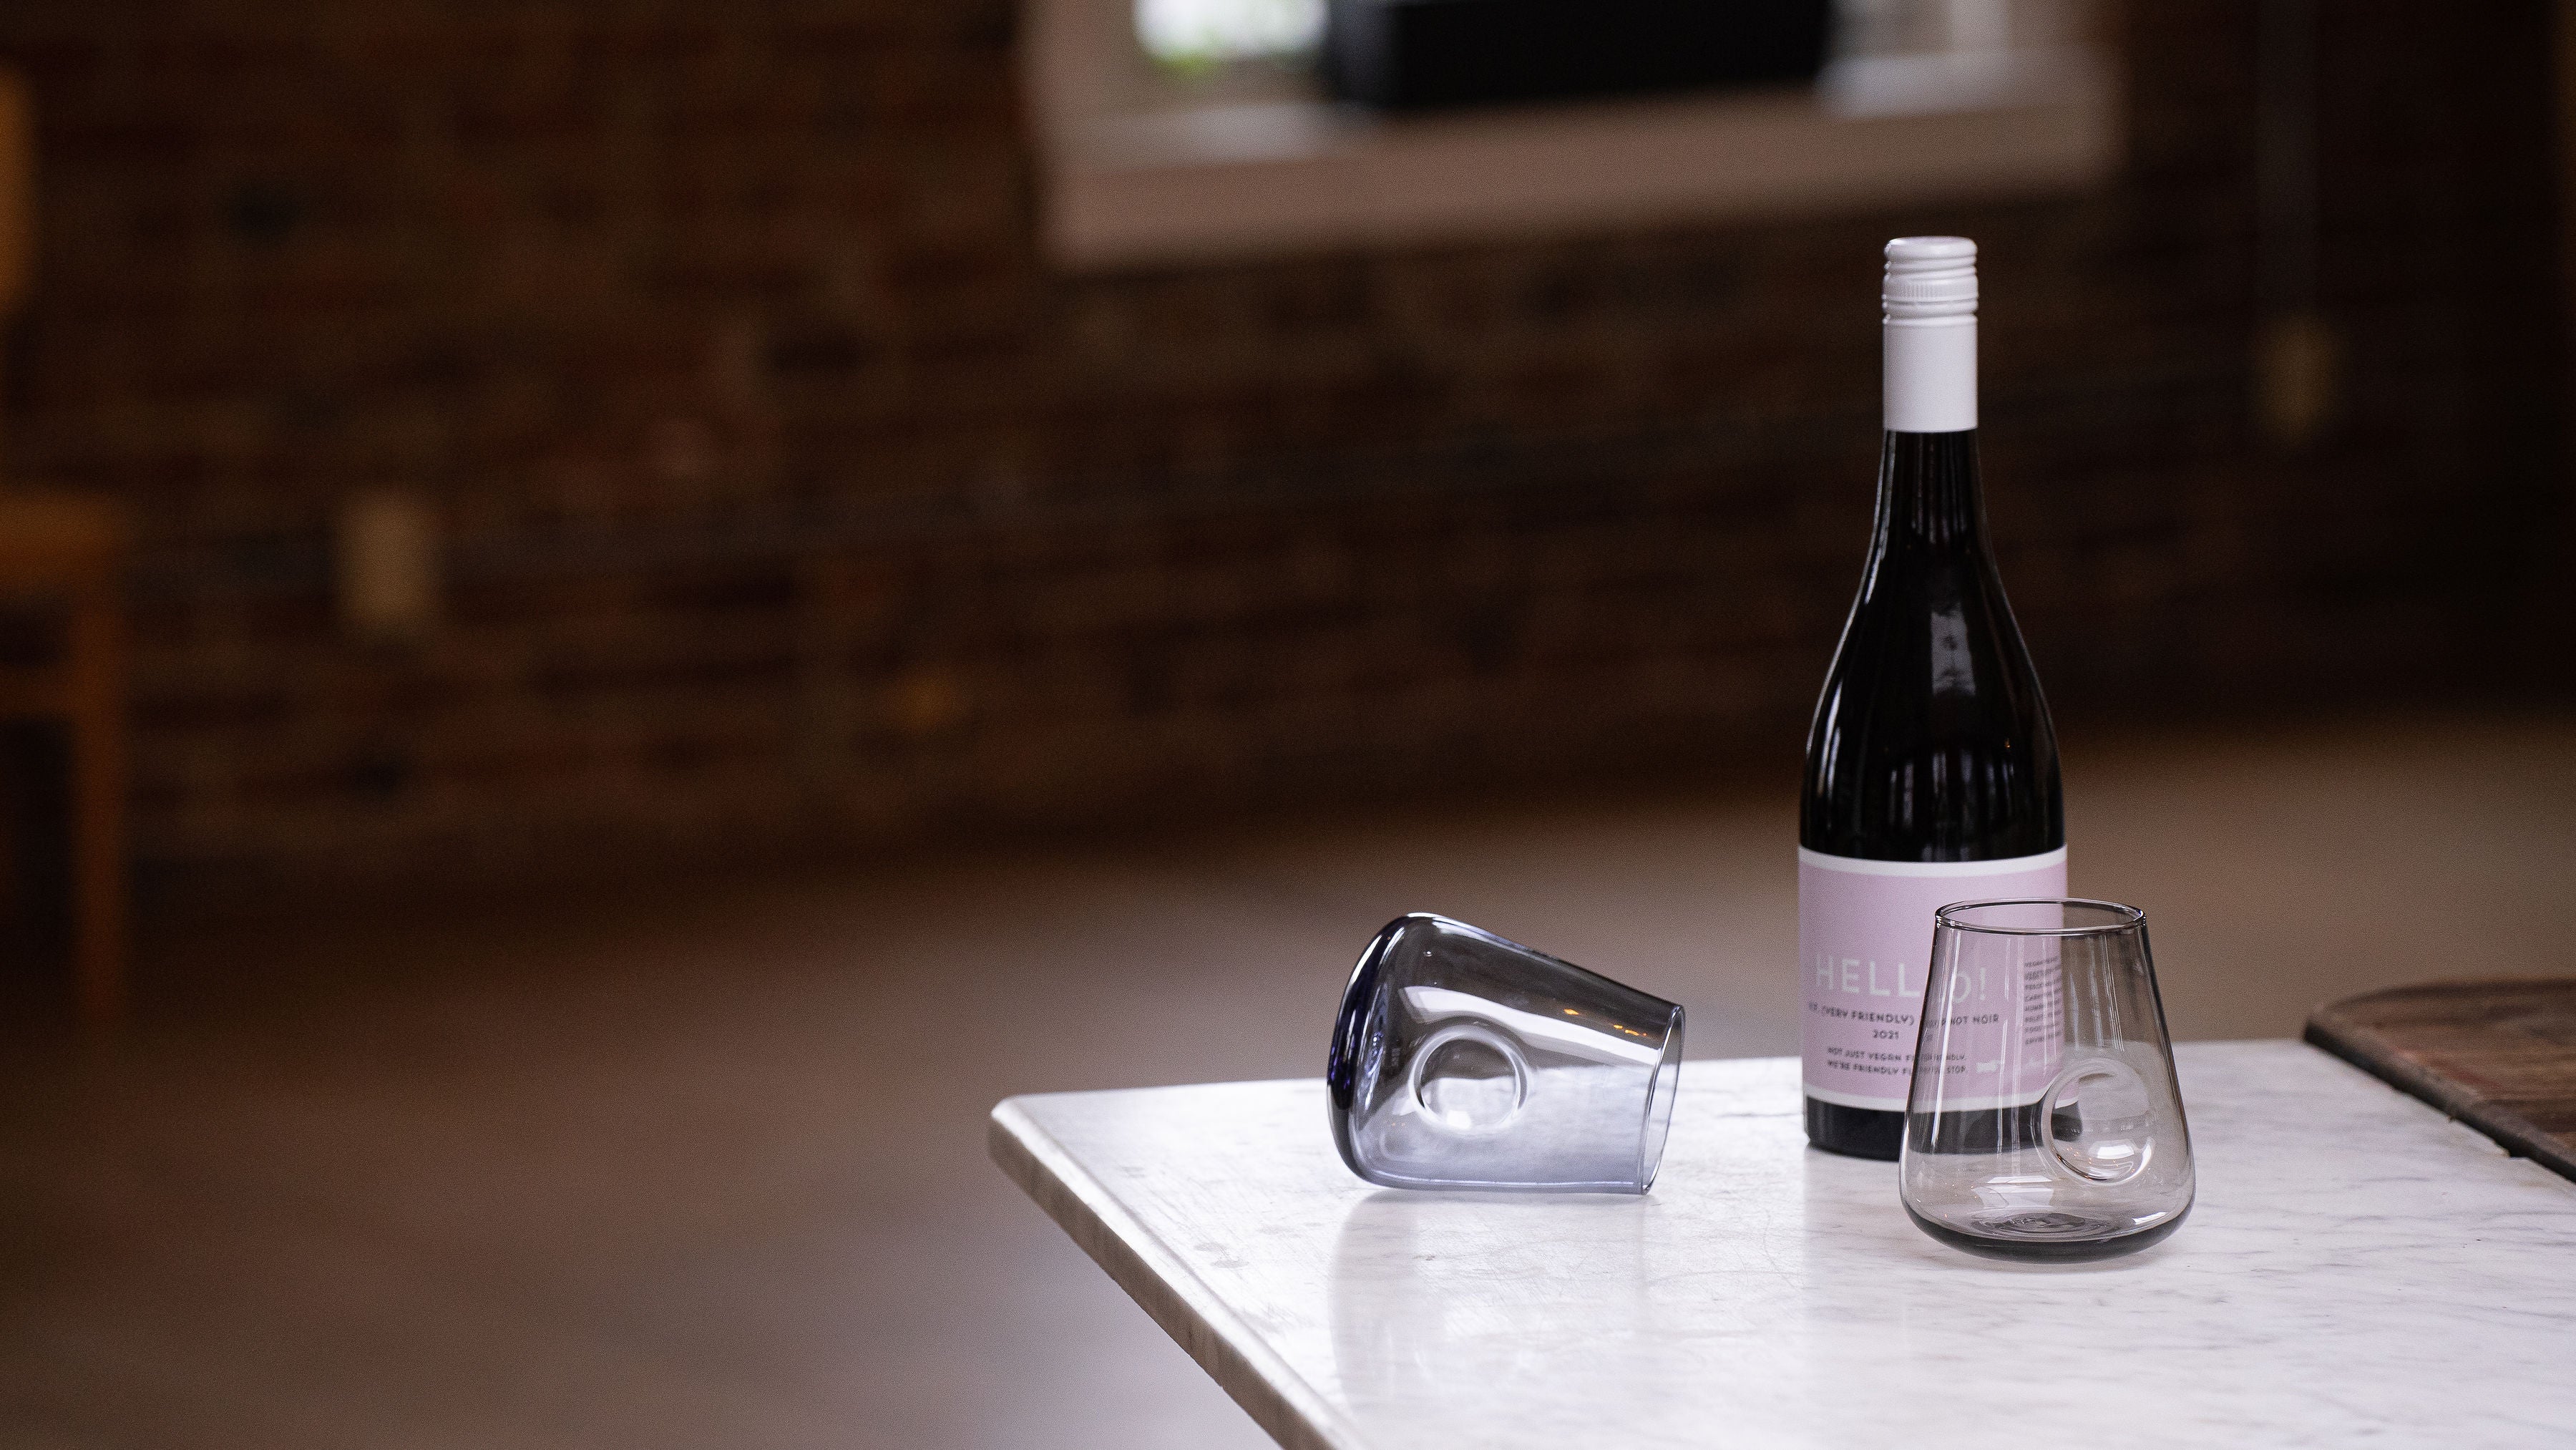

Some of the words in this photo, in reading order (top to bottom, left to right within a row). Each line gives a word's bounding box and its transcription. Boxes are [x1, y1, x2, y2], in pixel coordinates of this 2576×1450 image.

[1851, 1010, 1915, 1026] FRIENDLY)
[1941, 1015, 1969, 1026] PNOT
[1972, 1013, 1999, 1026] NOIR
[1872, 1028, 1900, 1040] 2021
[1868, 1051, 1901, 1061] VEGAN
[1853, 1063, 1899, 1075] FRIENDLY
